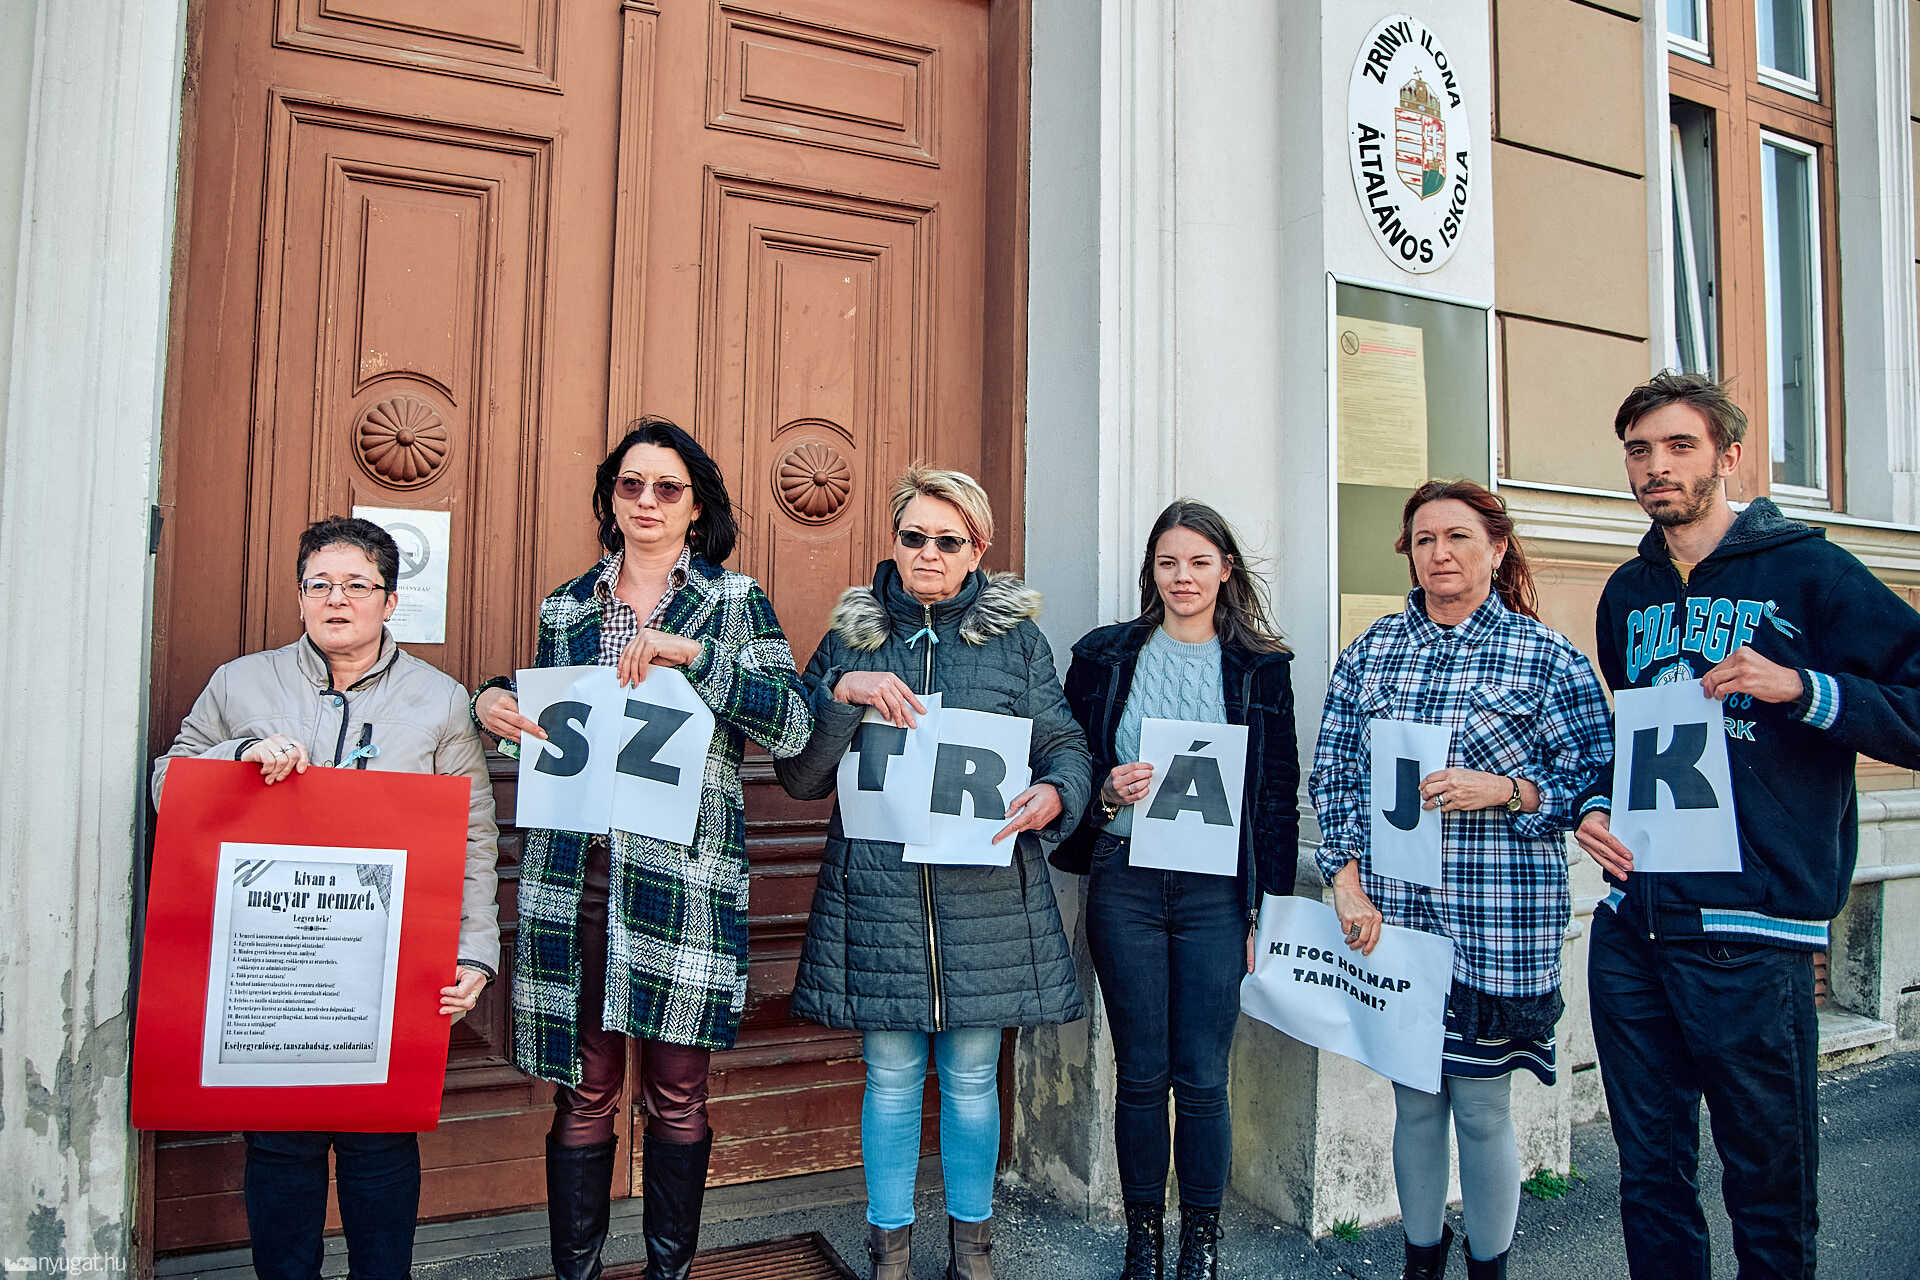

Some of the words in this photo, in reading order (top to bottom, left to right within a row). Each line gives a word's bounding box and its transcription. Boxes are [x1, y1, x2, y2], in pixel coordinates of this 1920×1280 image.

[1420, 28, 1461, 109] ILONA
[1357, 122, 1434, 264] ÁLTALÁNOS
[1438, 151, 1468, 249] ISKOLA
[534, 700, 593, 777] S
[616, 698, 695, 787] Z
[849, 721, 909, 792] T
[929, 742, 1007, 821] R
[1145, 740, 1234, 827] Á
[1381, 757, 1421, 831] J
[1628, 721, 1720, 812] K
[247, 890, 310, 912] magyar
[317, 889, 375, 911] nemzet.
[329, 875, 336, 886] a
[1269, 941, 1290, 956] KI
[1296, 945, 1334, 965] FOG
[1338, 955, 1411, 993] HOLNAP
